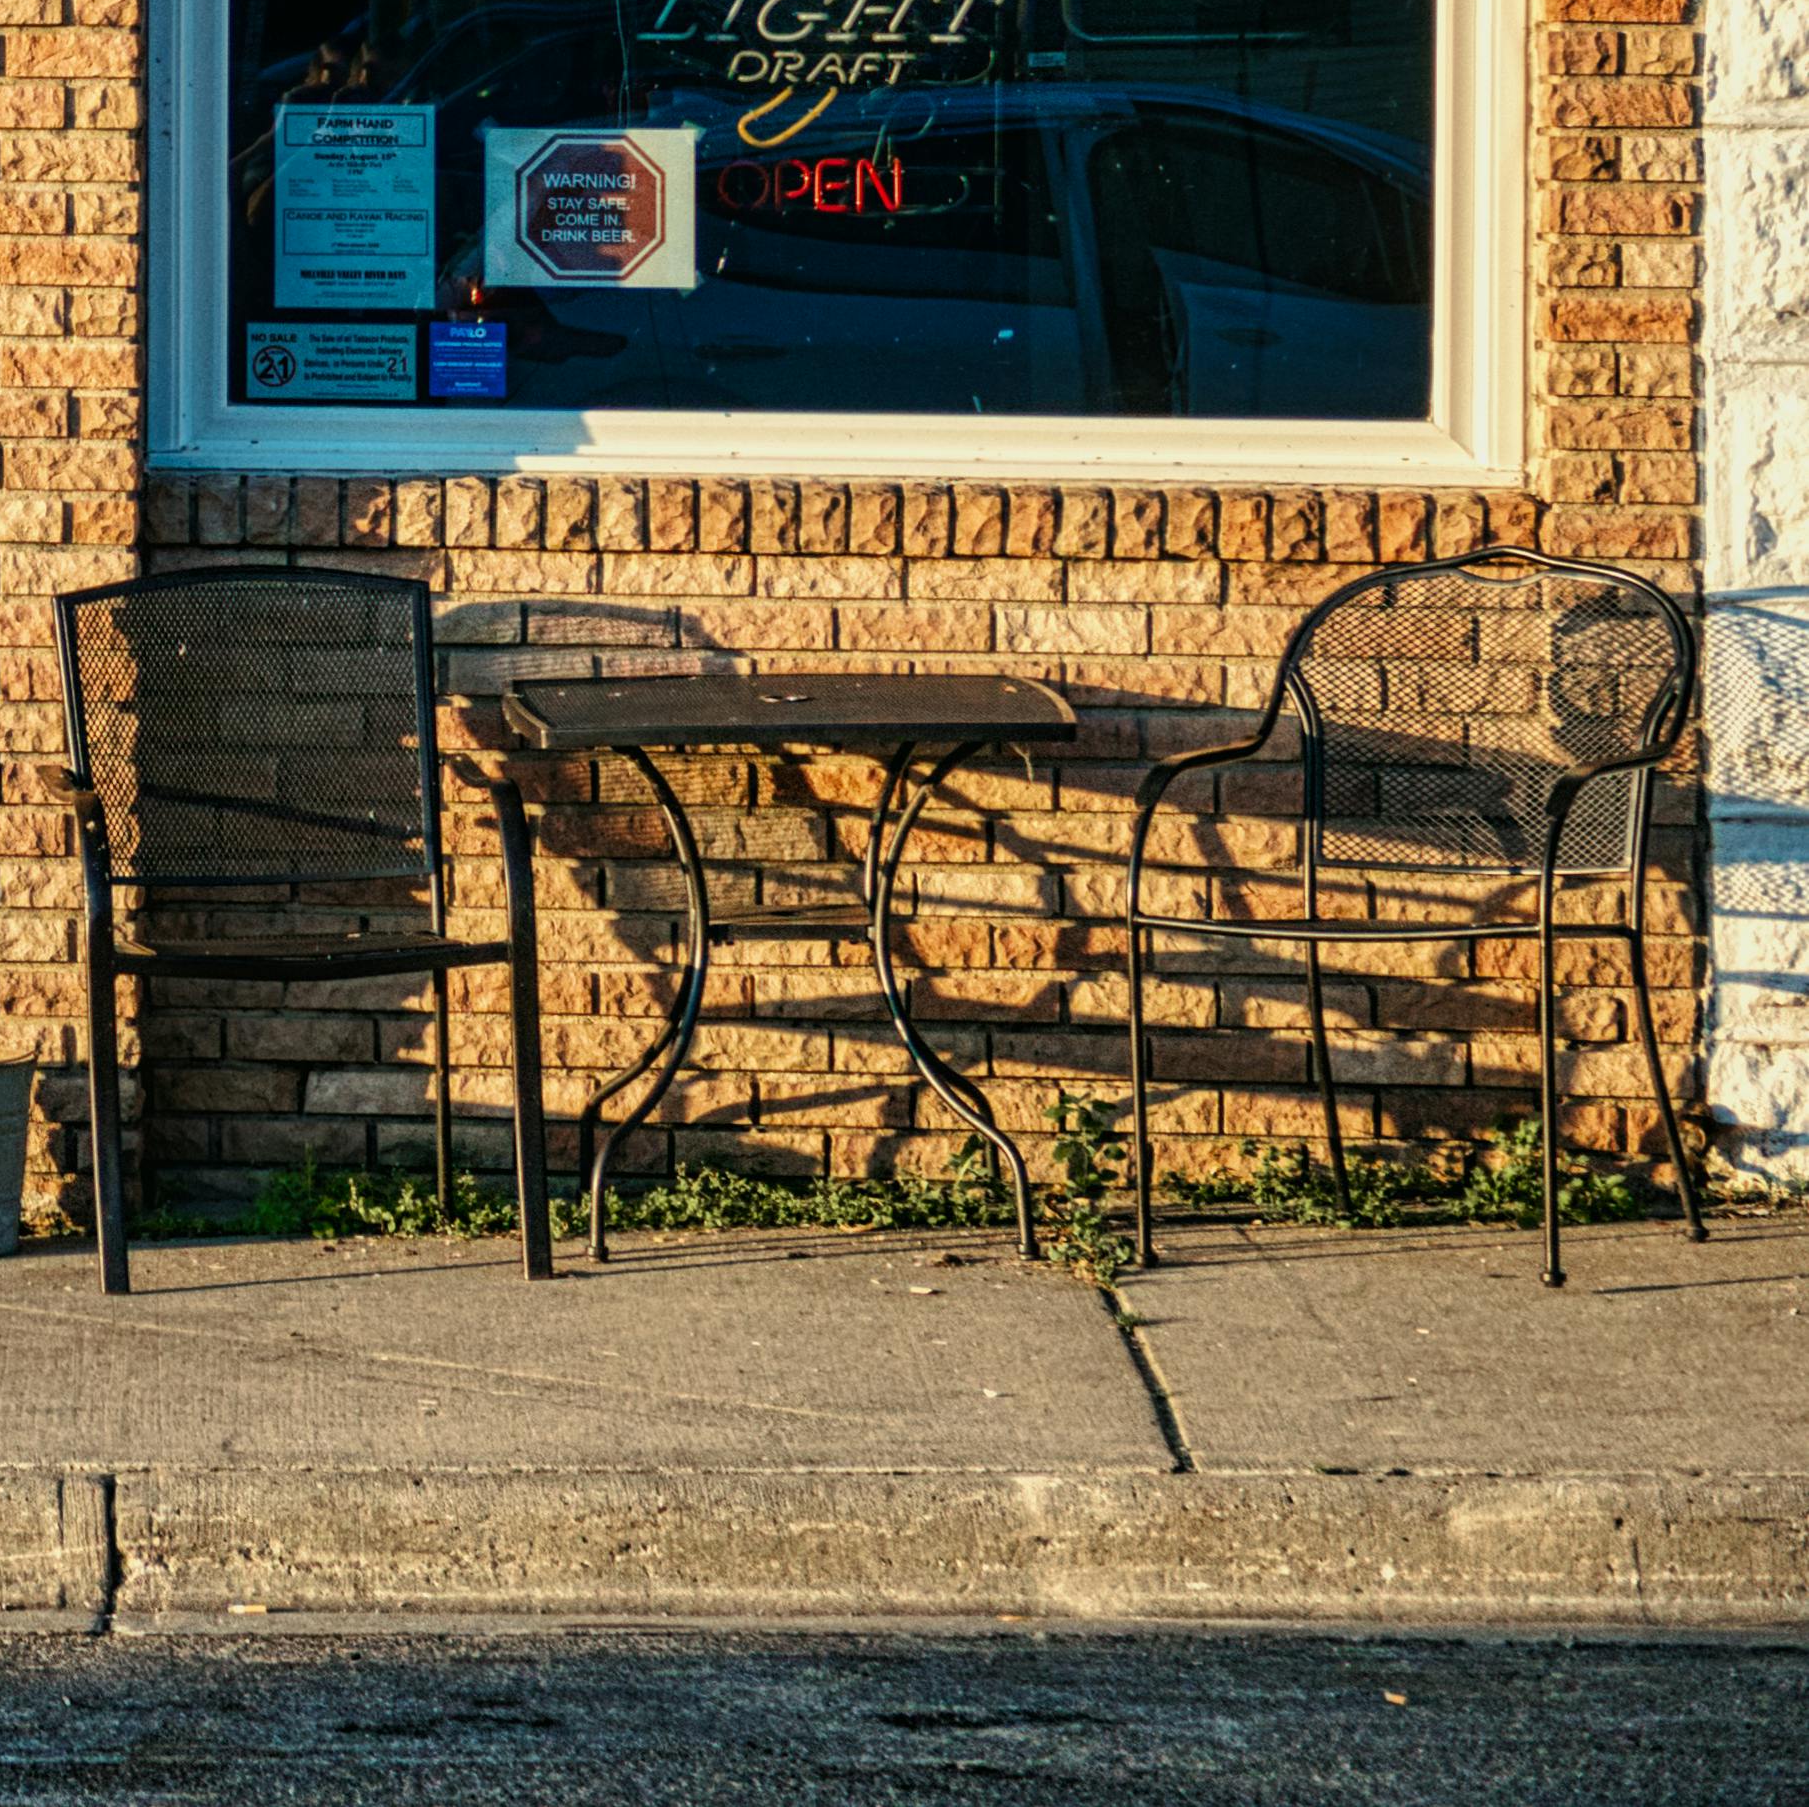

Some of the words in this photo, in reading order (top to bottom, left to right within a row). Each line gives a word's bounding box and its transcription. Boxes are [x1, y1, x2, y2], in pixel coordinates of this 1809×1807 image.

[728, 51, 917, 85] DRAFT
[317, 118, 353, 129] FARM
[356, 118, 394, 129] HAND
[311, 134, 399, 146] COMPETITION
[542, 173, 637, 190] WARNING!
[716, 156, 903, 214] OPEN
[547, 197, 586, 211] STAY
[587, 197, 632, 211] SAFE.
[286, 211, 324, 221] CANOE
[325, 212, 348, 221] AND
[349, 212, 383, 221] KAYAK
[384, 212, 424, 221] RACING
[554, 213, 600, 227] COME
[603, 213, 622, 227] IN.
[541, 229, 587, 243] DRINK
[591, 229, 637, 243] BEER.
[251, 333, 266, 342] NO
[269, 333, 297, 342] SALE
[258, 355, 289, 379] 21
[386, 357, 407, 372] 21
